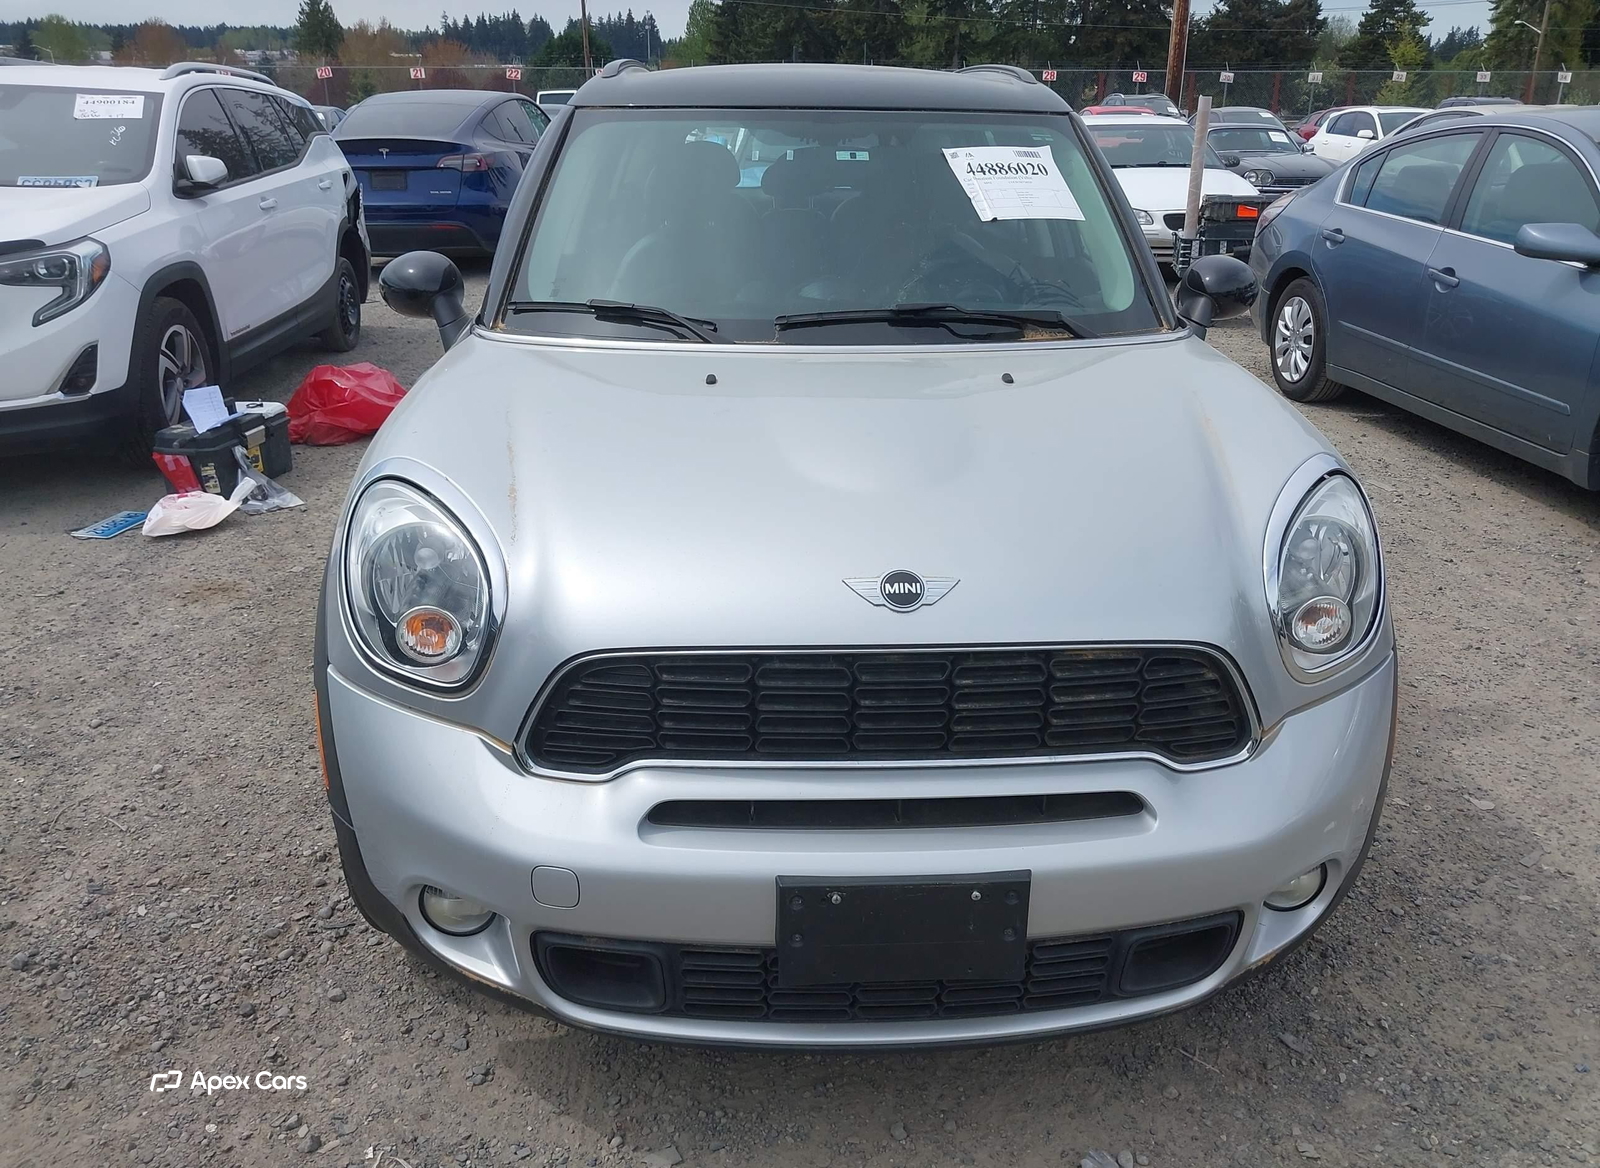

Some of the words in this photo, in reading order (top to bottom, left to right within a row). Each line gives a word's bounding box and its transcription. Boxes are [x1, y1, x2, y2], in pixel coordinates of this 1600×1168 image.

[318, 69, 331, 77] 20
[413, 69, 423, 78] 21
[507, 70, 519, 79] 22
[1044, 71, 1055, 80] 28
[1134, 73, 1146, 81] 29
[966, 162, 1049, 176] 44886020
[885, 582, 921, 594] MINI
